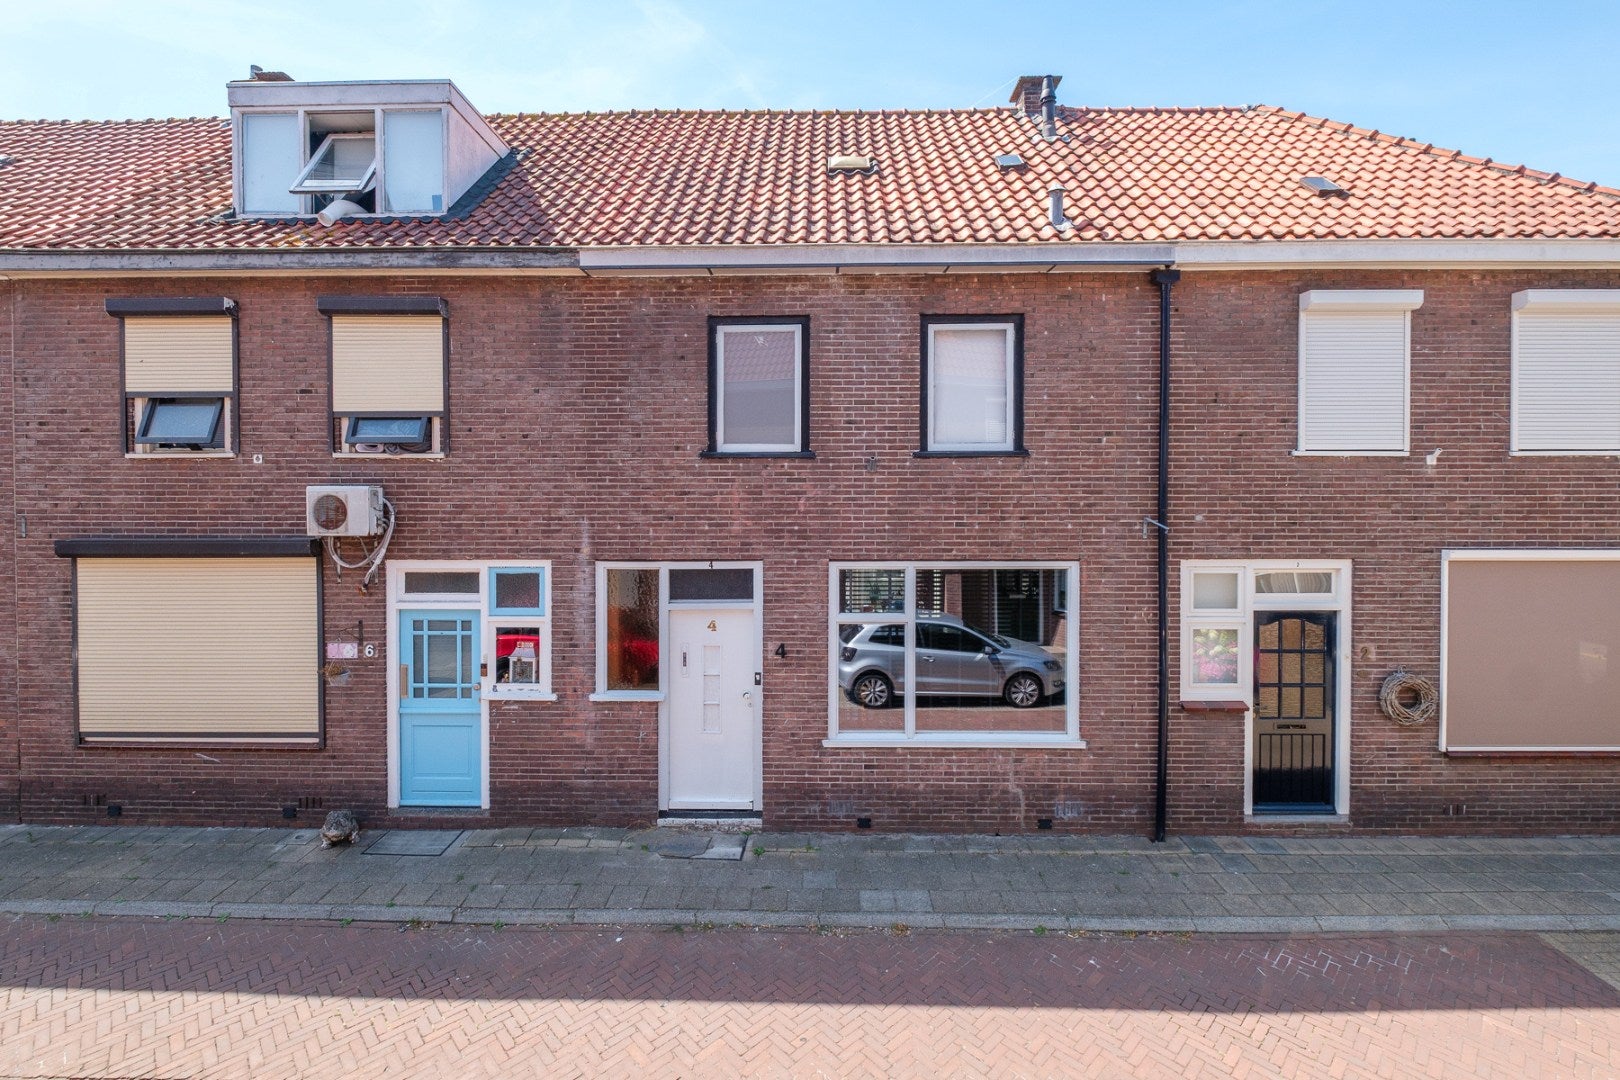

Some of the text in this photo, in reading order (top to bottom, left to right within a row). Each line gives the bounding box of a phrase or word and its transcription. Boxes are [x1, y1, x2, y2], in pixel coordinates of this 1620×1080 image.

[707, 619, 717, 631] 4
[365, 644, 374, 657] 6
[775, 643, 787, 658] 4
[1360, 646, 1370, 661] 2
